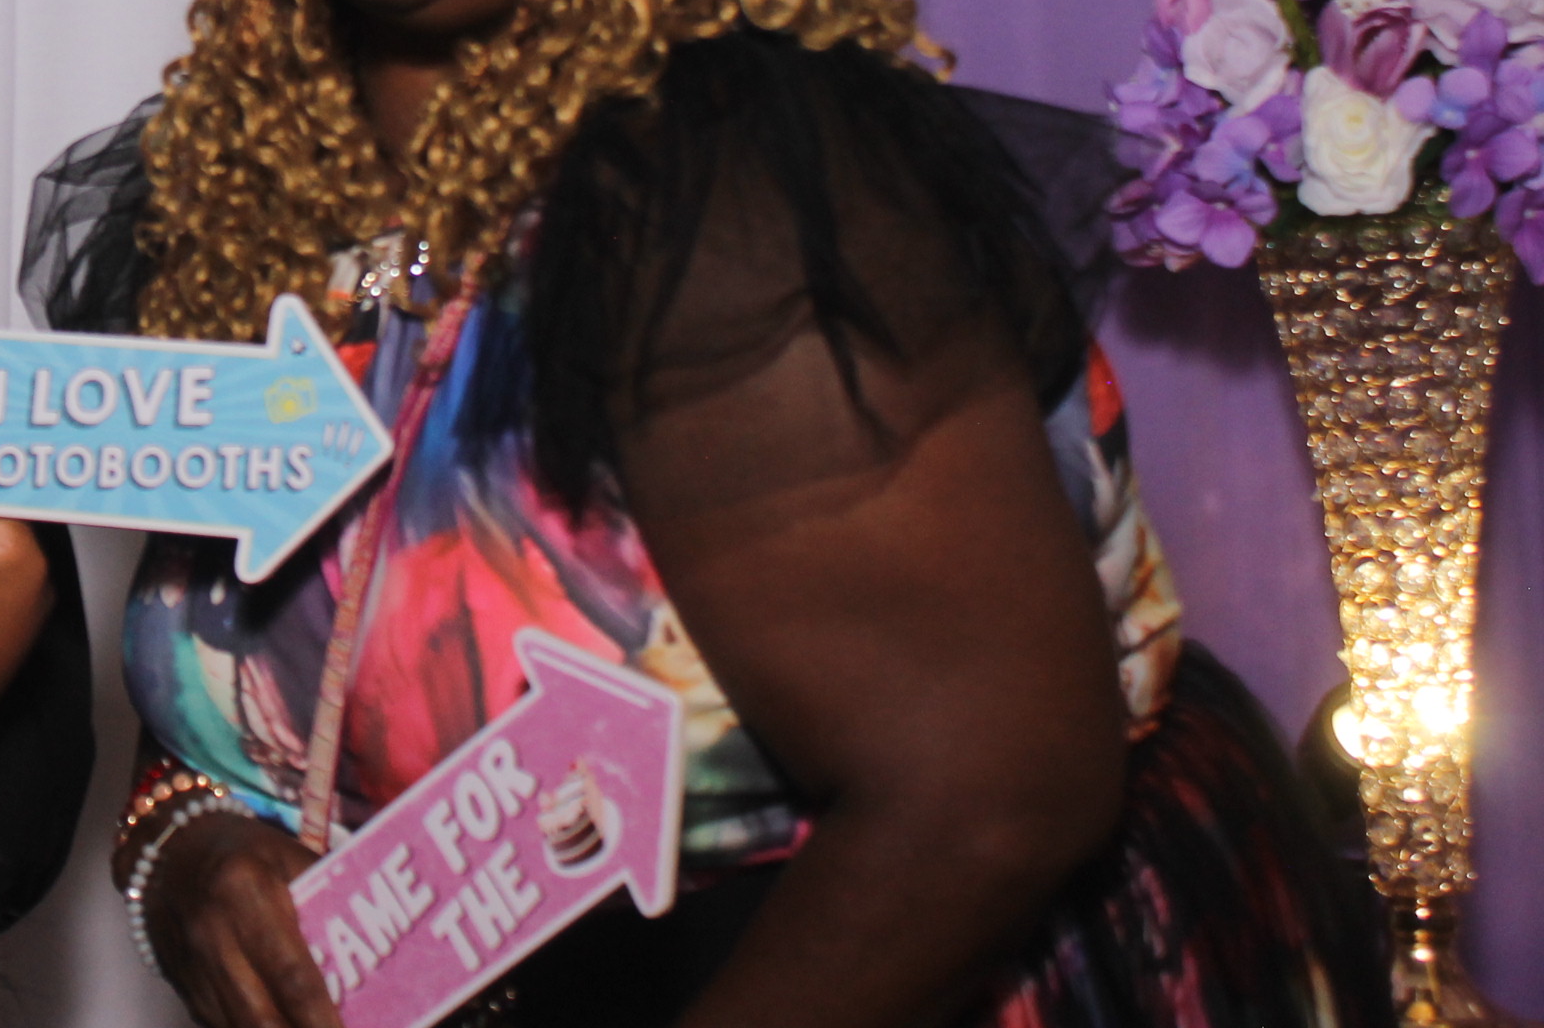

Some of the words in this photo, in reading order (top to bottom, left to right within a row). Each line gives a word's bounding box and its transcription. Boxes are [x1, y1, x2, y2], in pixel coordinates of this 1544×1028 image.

[30, 367, 215, 427] LOVE
[422, 738, 538, 875] FOR
[430, 841, 542, 972] THE
